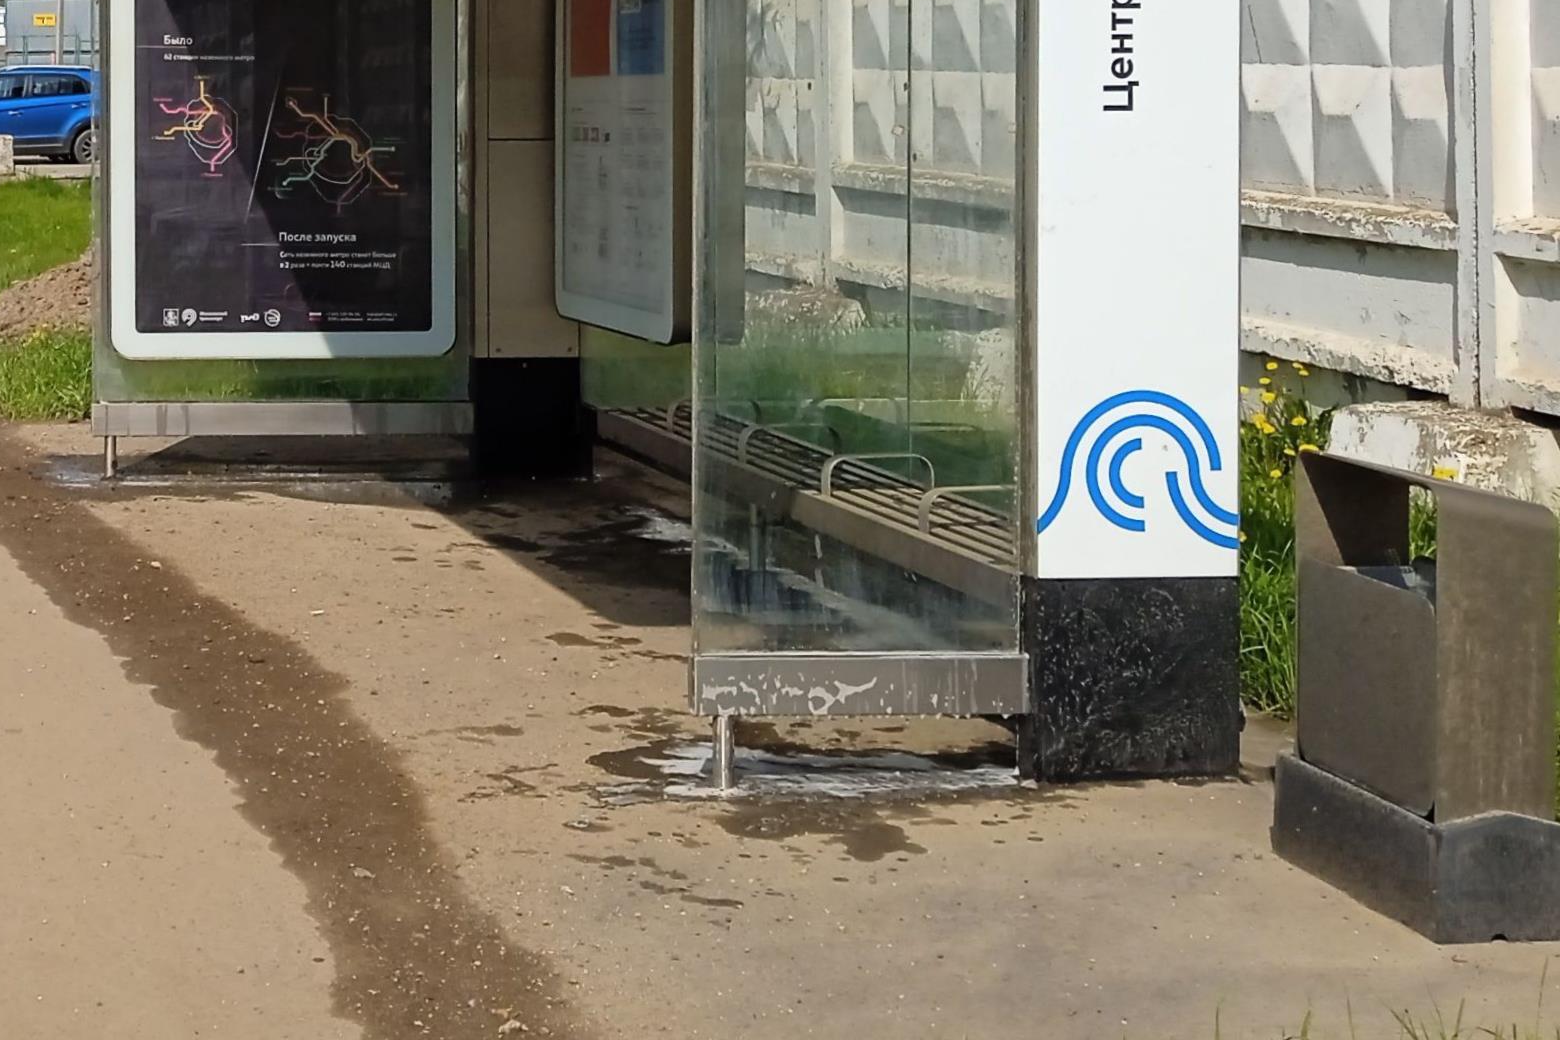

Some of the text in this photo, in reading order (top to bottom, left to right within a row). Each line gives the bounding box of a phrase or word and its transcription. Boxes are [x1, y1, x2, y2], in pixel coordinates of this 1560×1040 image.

[163, 34, 193, 45] Было
[279, 231, 357, 244] После запуска
[330, 260, 346, 269] 140
